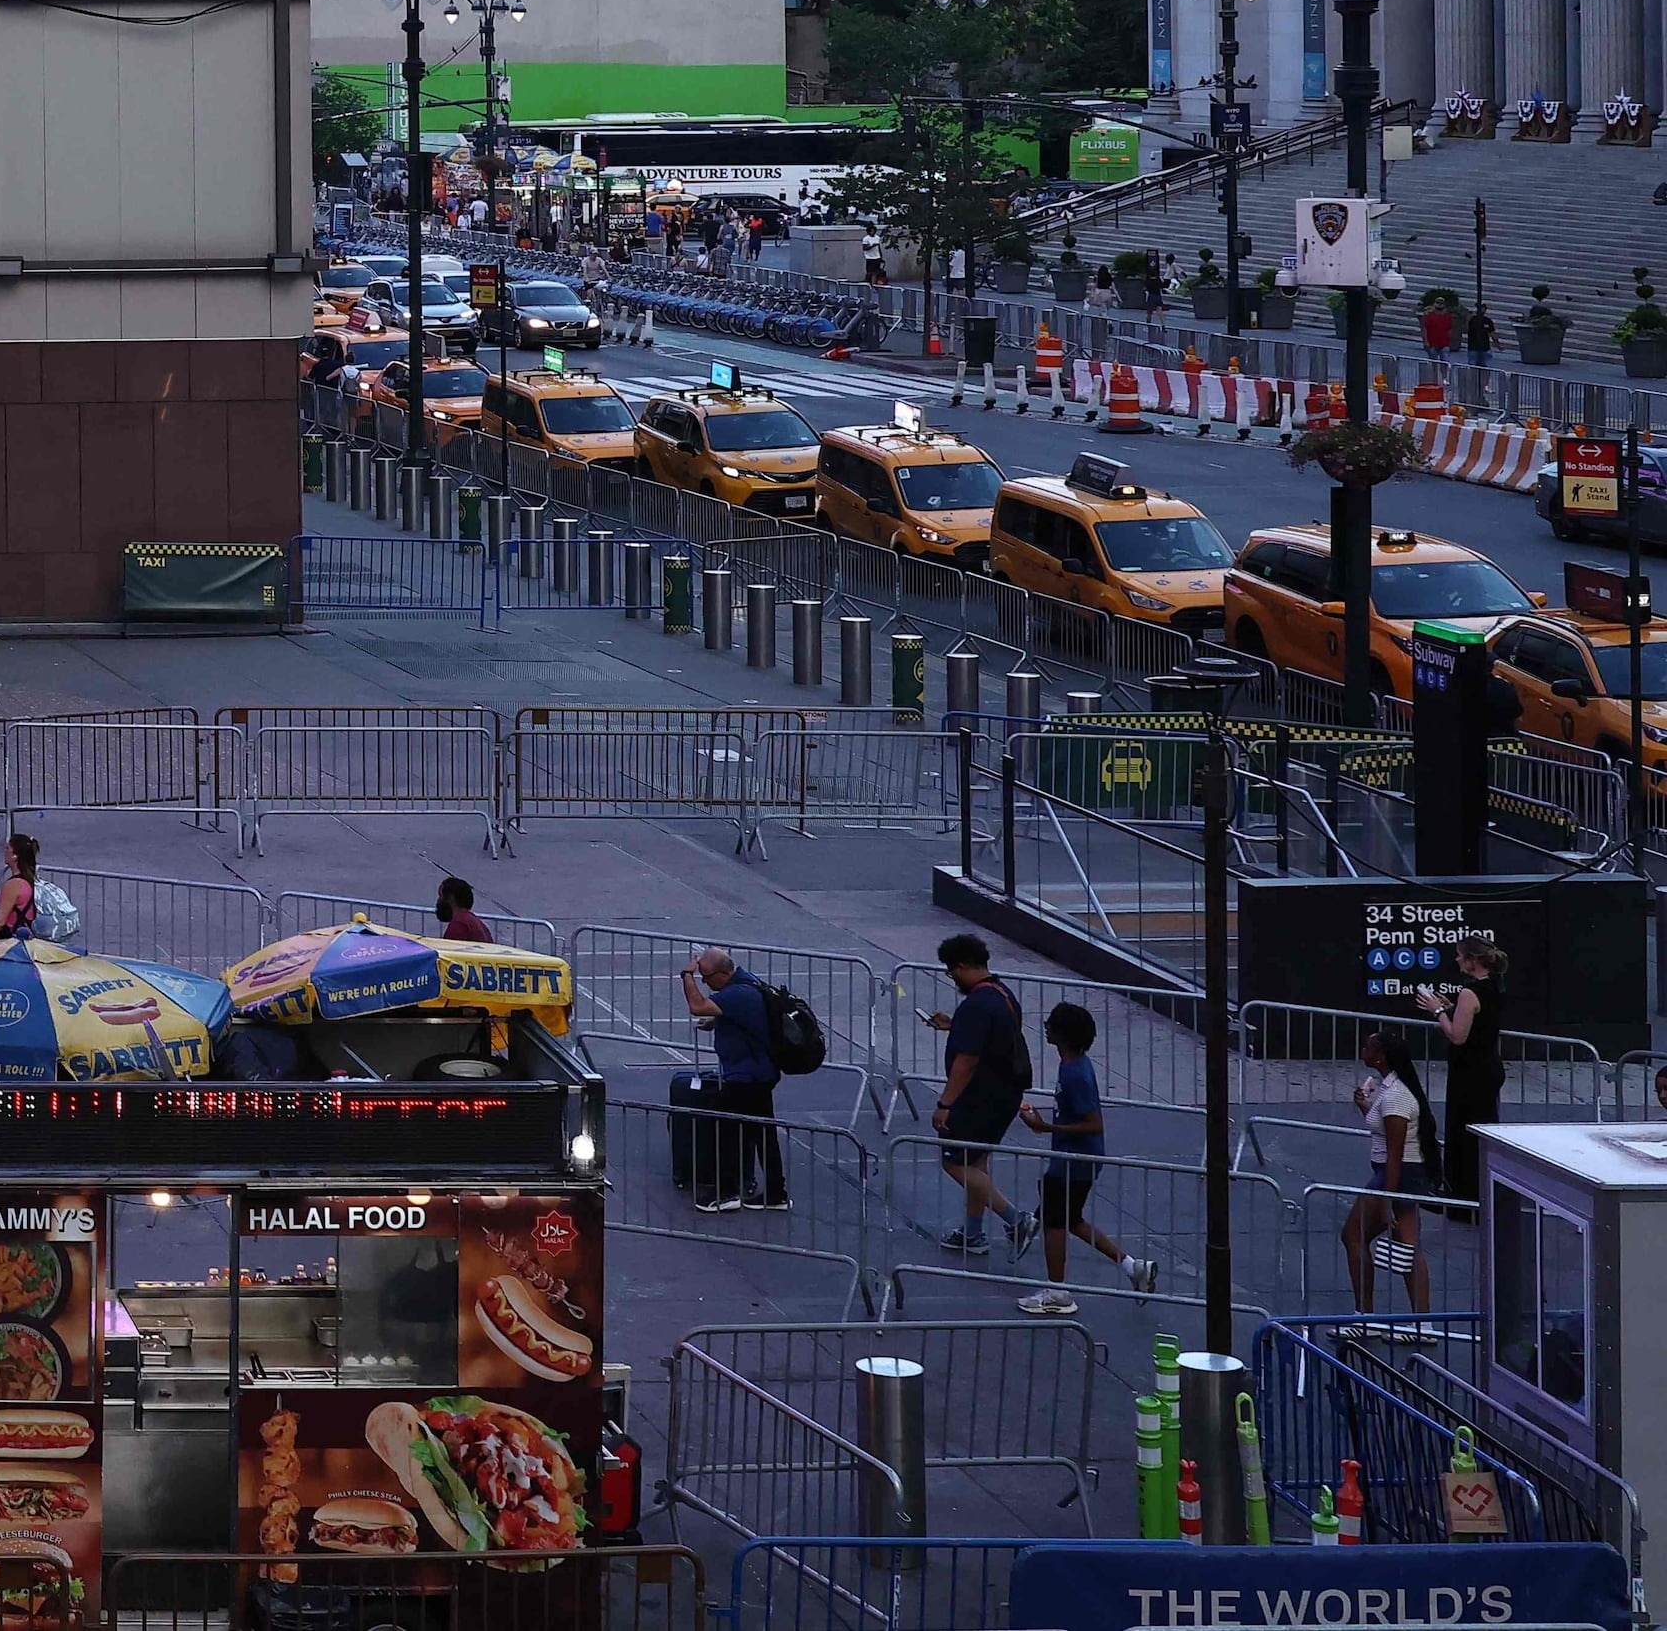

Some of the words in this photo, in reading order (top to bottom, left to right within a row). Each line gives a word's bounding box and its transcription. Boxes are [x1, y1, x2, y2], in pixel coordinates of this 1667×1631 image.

[637, 168, 730, 180] ADVENTURE
[734, 168, 781, 179] TOURS
[1565, 462, 1576, 470] No
[1578, 463, 1615, 474] Standing
[1589, 486, 1608, 494] TAXI
[1587, 493, 1610, 501] Stand
[137, 557, 166, 567] TAXI
[1414, 641, 1456, 675] Subway
[1366, 905, 1394, 923] 34
[1402, 904, 1464, 923] Street
[1366, 927, 1415, 945] Penn
[444, 963, 562, 996] SABRETT
[328, 986, 360, 1003] WE'RE
[363, 984, 378, 998] ON
[380, 983, 388, 995] A
[390, 979, 415, 994] ROLL
[417, 975, 429, 988] !!!
[1401, 984, 1414, 994] at
[57, 977, 135, 1016] SABRETT
[4, 1064, 30, 1076] ROLL
[31, 1065, 45, 1077] !!!
[249, 1207, 340, 1231] HALAL
[348, 1206, 427, 1230] FOOD
[544, 1237, 566, 1245] HALAL
[328, 1491, 351, 1500] PHILLY
[352, 1490, 380, 1499] CHEESE
[381, 1491, 403, 1503] STEAK
[1128, 1587, 1241, 1626] THE
[1257, 1584, 1514, 1626] WORLD'S
